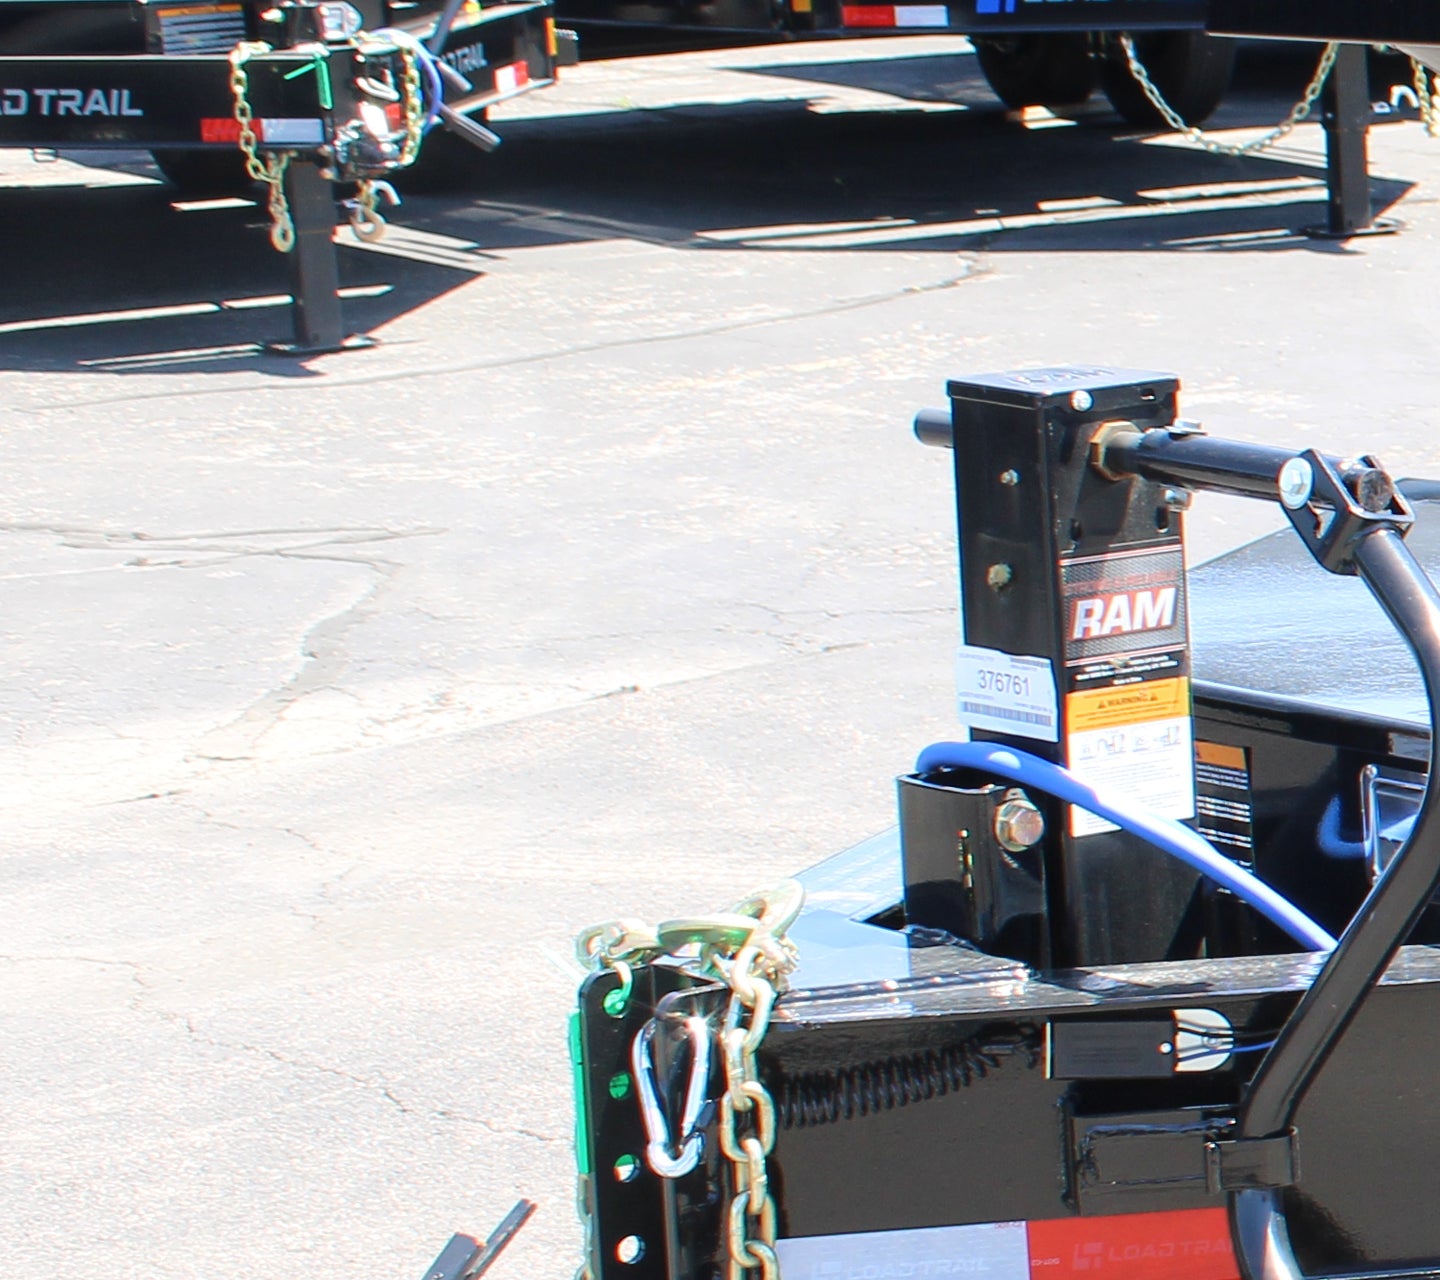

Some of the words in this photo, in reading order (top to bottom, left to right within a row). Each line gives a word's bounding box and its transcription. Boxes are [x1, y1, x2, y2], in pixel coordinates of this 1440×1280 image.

[33, 88, 144, 116] TRAIL
[1072, 587, 1177, 639] RAM
[976, 668, 1031, 698] 376761
[1106, 1241, 1176, 1263] LOAD
